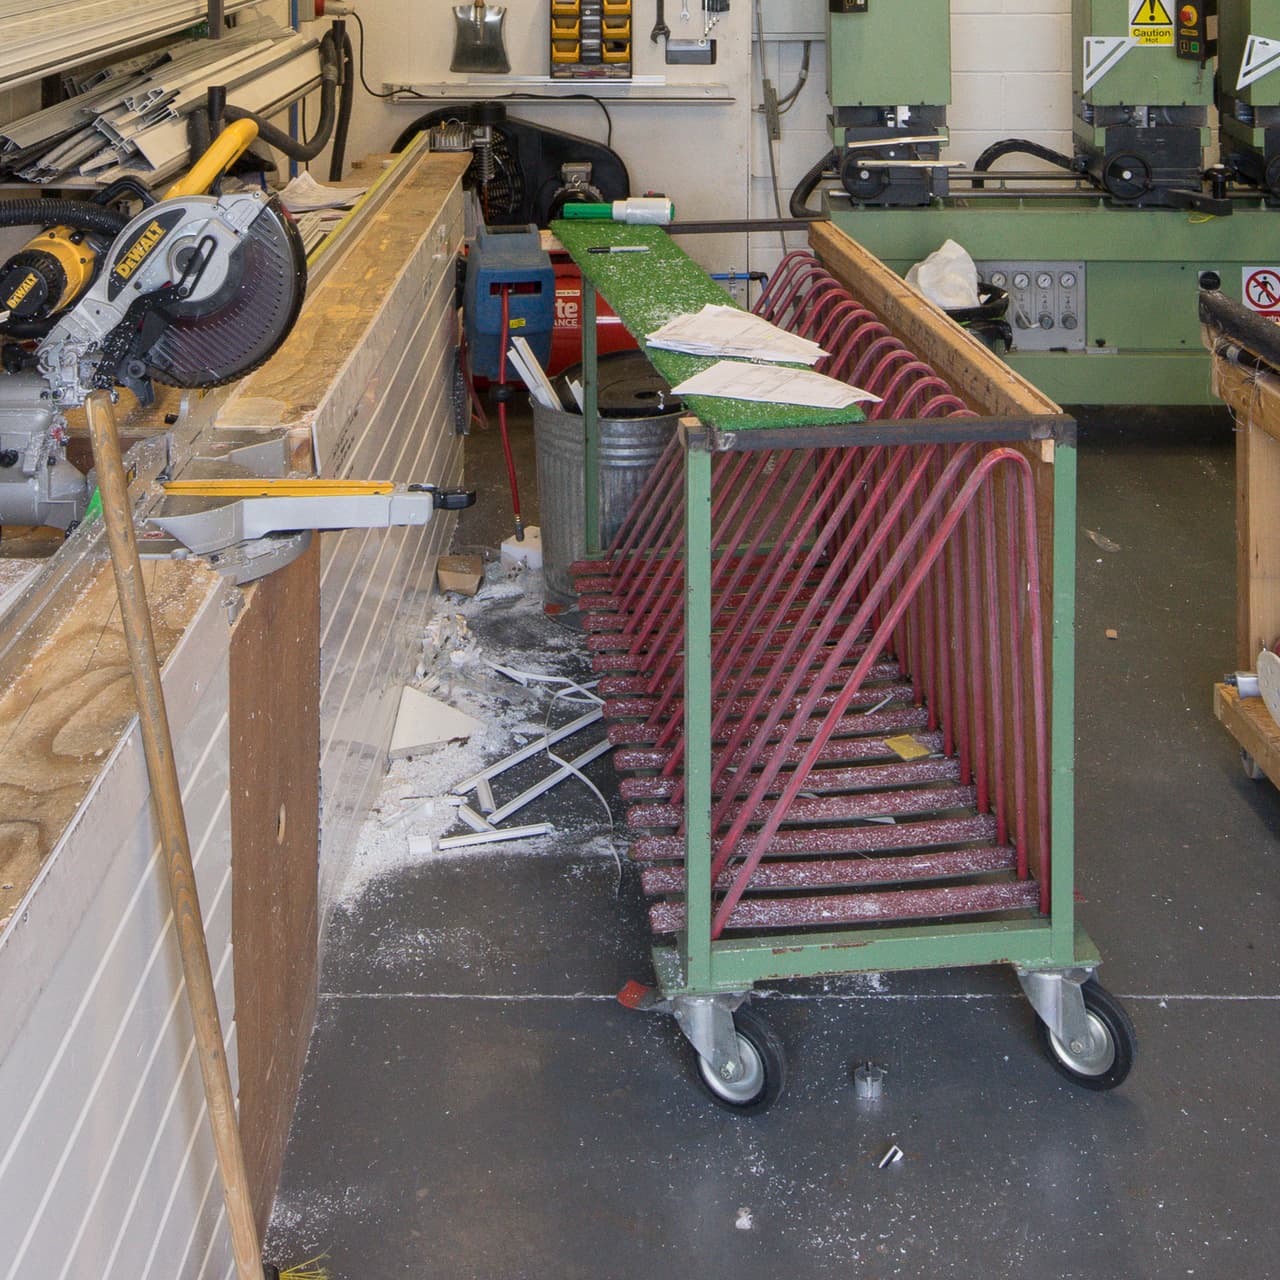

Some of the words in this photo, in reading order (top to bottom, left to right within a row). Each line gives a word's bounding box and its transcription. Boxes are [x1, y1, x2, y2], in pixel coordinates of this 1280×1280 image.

[1133, 29, 1171, 37] Caution
[116, 220, 166, 279] DEWALT
[6, 273, 39, 309] DEWALT
